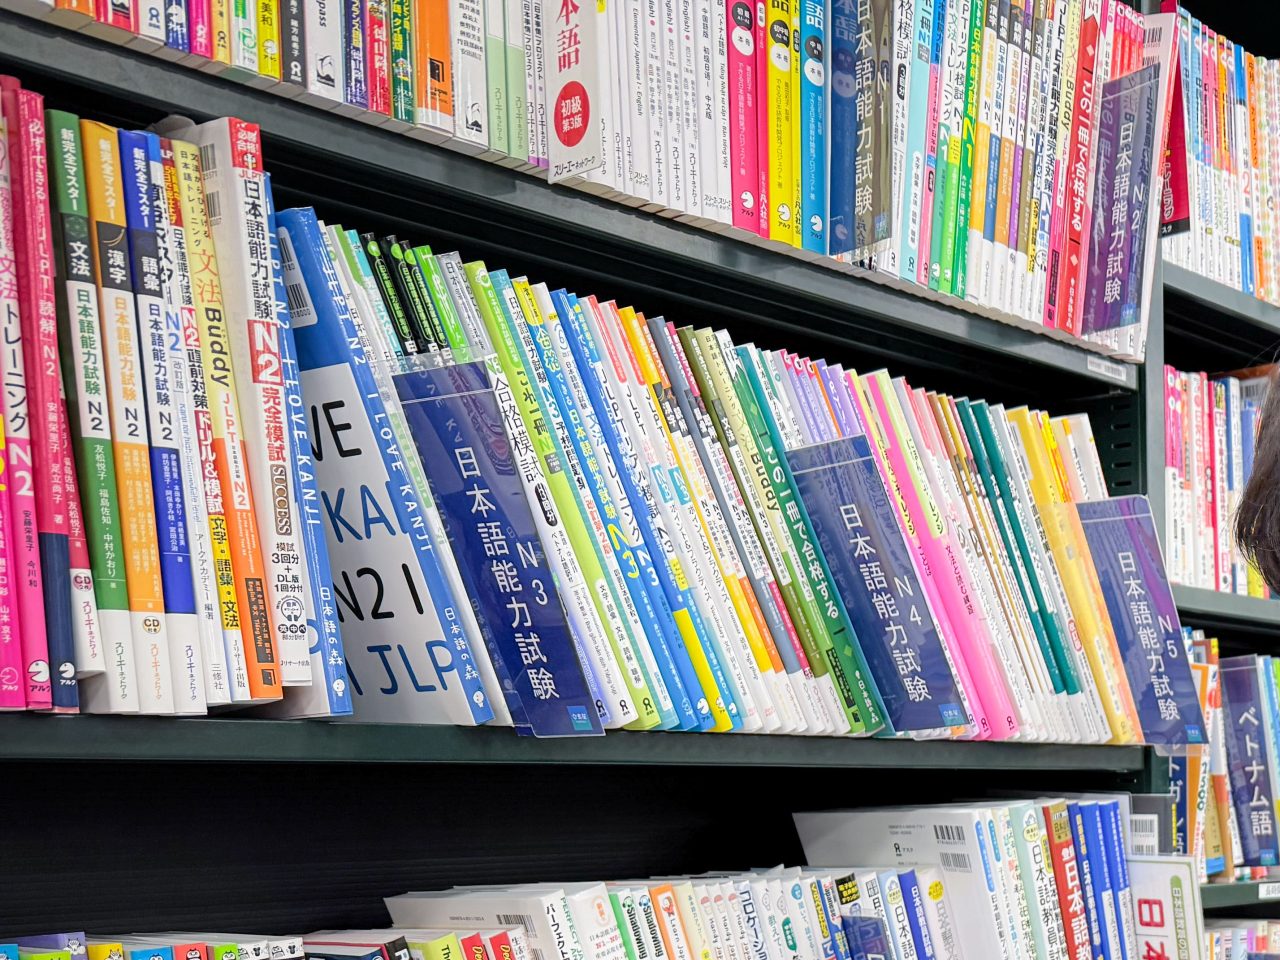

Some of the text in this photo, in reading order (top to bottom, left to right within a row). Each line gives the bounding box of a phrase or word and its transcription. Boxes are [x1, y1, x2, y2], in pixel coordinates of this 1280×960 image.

[561, 96, 582, 117] 初級
[562, 116, 582, 133] 第3版
[855, 0, 888, 215] 日本語能力試験 N1
[61, 128, 78, 211] 新完全マスター
[98, 138, 116, 220] 新完全マスター
[133, 147, 152, 228] 新完全マスター
[238, 170, 262, 181] JLPT
[553, 155, 596, 177] スリーエーネットワーク
[1104, 123, 1144, 303] 日本語能力試験 N2
[69, 241, 91, 276] 文法
[108, 249, 127, 284] 漢字
[141, 257, 160, 291] 語彙
[165, 311, 181, 352] N2
[77, 289, 104, 431] 日本語能力試験 N2
[114, 297, 139, 437] 日本語能力試験 N2
[149, 303, 173, 441] 日本語能力試験 N2
[223, 393, 236, 443] JLPT
[254, 322, 287, 463] N2 完全模試
[9, 443, 34, 497] N2
[751, 453, 780, 512] Buddy
[270, 465, 292, 535] SUCCESS
[271, 553, 299, 565] 3回分
[277, 574, 299, 583] DL版
[455, 446, 560, 701] 日本語能力試験
[518, 540, 549, 607] N3
[608, 523, 640, 580] N3
[75, 575, 91, 585] CD
[839, 503, 932, 703] 日本語能力試験 N4
[319, 586, 344, 666] 日本語の森
[1116, 551, 1181, 722] 日本語能力試験 N5
[211, 664, 224, 691] 三修社
[1238, 706, 1272, 836] ベトナム語
[441, 944, 452, 960] The
[627, 904, 649, 960] Shadowing
[643, 903, 665, 958] Shadowing
